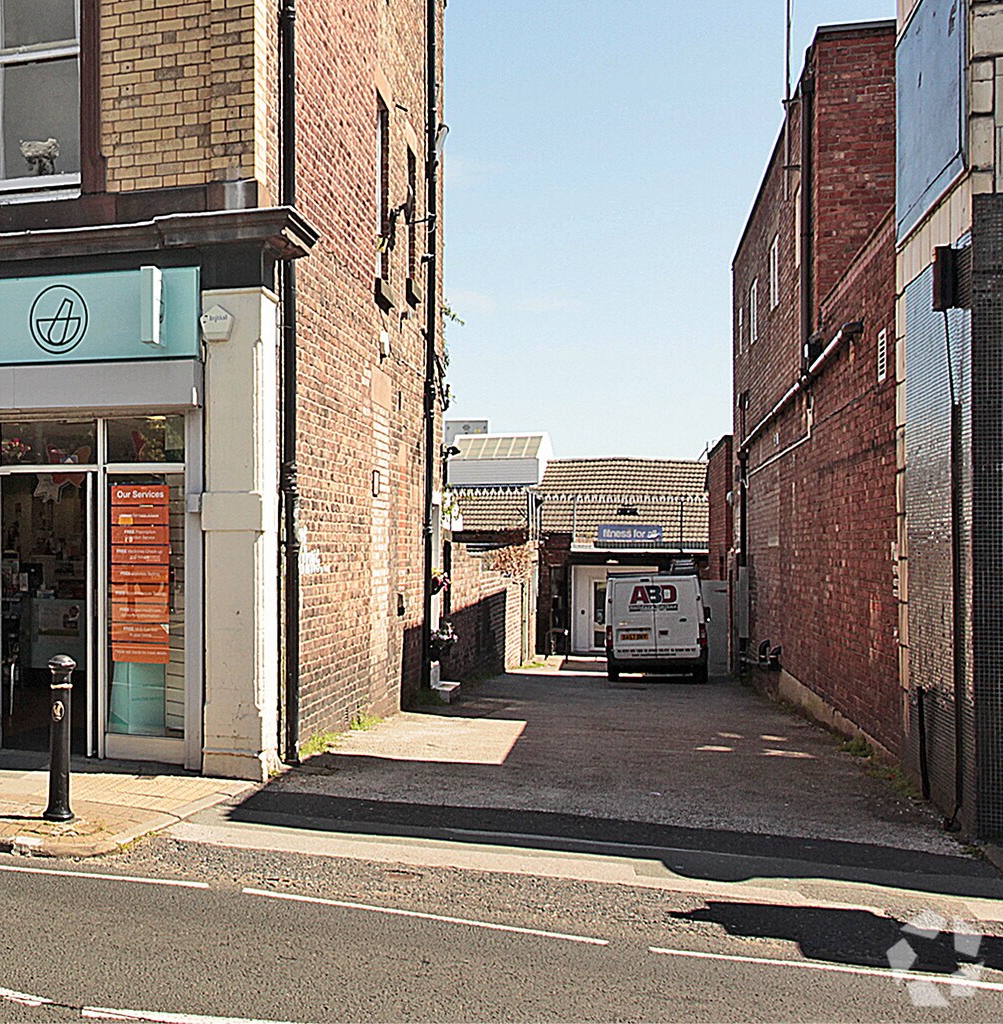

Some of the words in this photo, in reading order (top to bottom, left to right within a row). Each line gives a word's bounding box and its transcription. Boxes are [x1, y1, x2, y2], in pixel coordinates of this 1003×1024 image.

[116, 490, 131, 498] Our
[132, 490, 164, 499] Services
[633, 529, 646, 538] for
[629, 584, 678, 604] ABD
